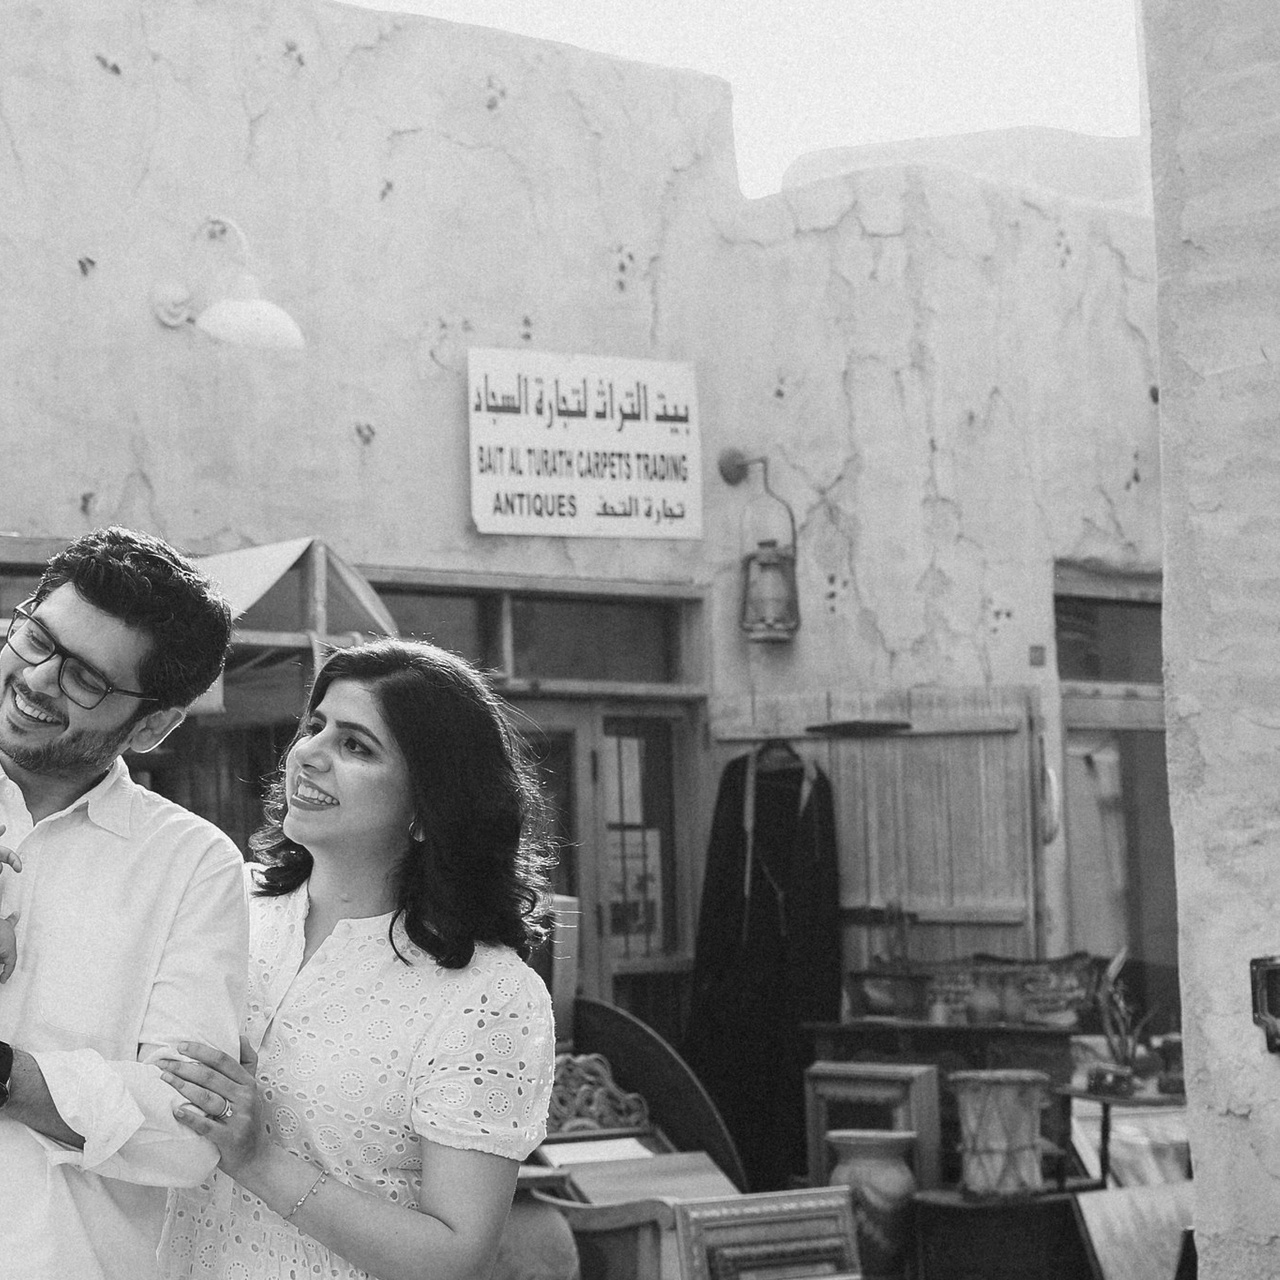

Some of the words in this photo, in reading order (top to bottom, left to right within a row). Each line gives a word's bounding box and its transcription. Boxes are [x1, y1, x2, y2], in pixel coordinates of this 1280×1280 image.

[475, 373, 528, 425] السجاد
[535, 377, 587, 429] لتجارة
[595, 379, 648, 432] التراث
[655, 393, 689, 436] بيت
[478, 445, 503, 475] BAIT
[509, 447, 523, 476] AL
[526, 448, 574, 477] TURATH
[577, 450, 631, 480] CARPETS
[634, 452, 688, 482] TRADING
[493, 493, 577, 517] ANTIQUES
[644, 497, 685, 525] تجارة
